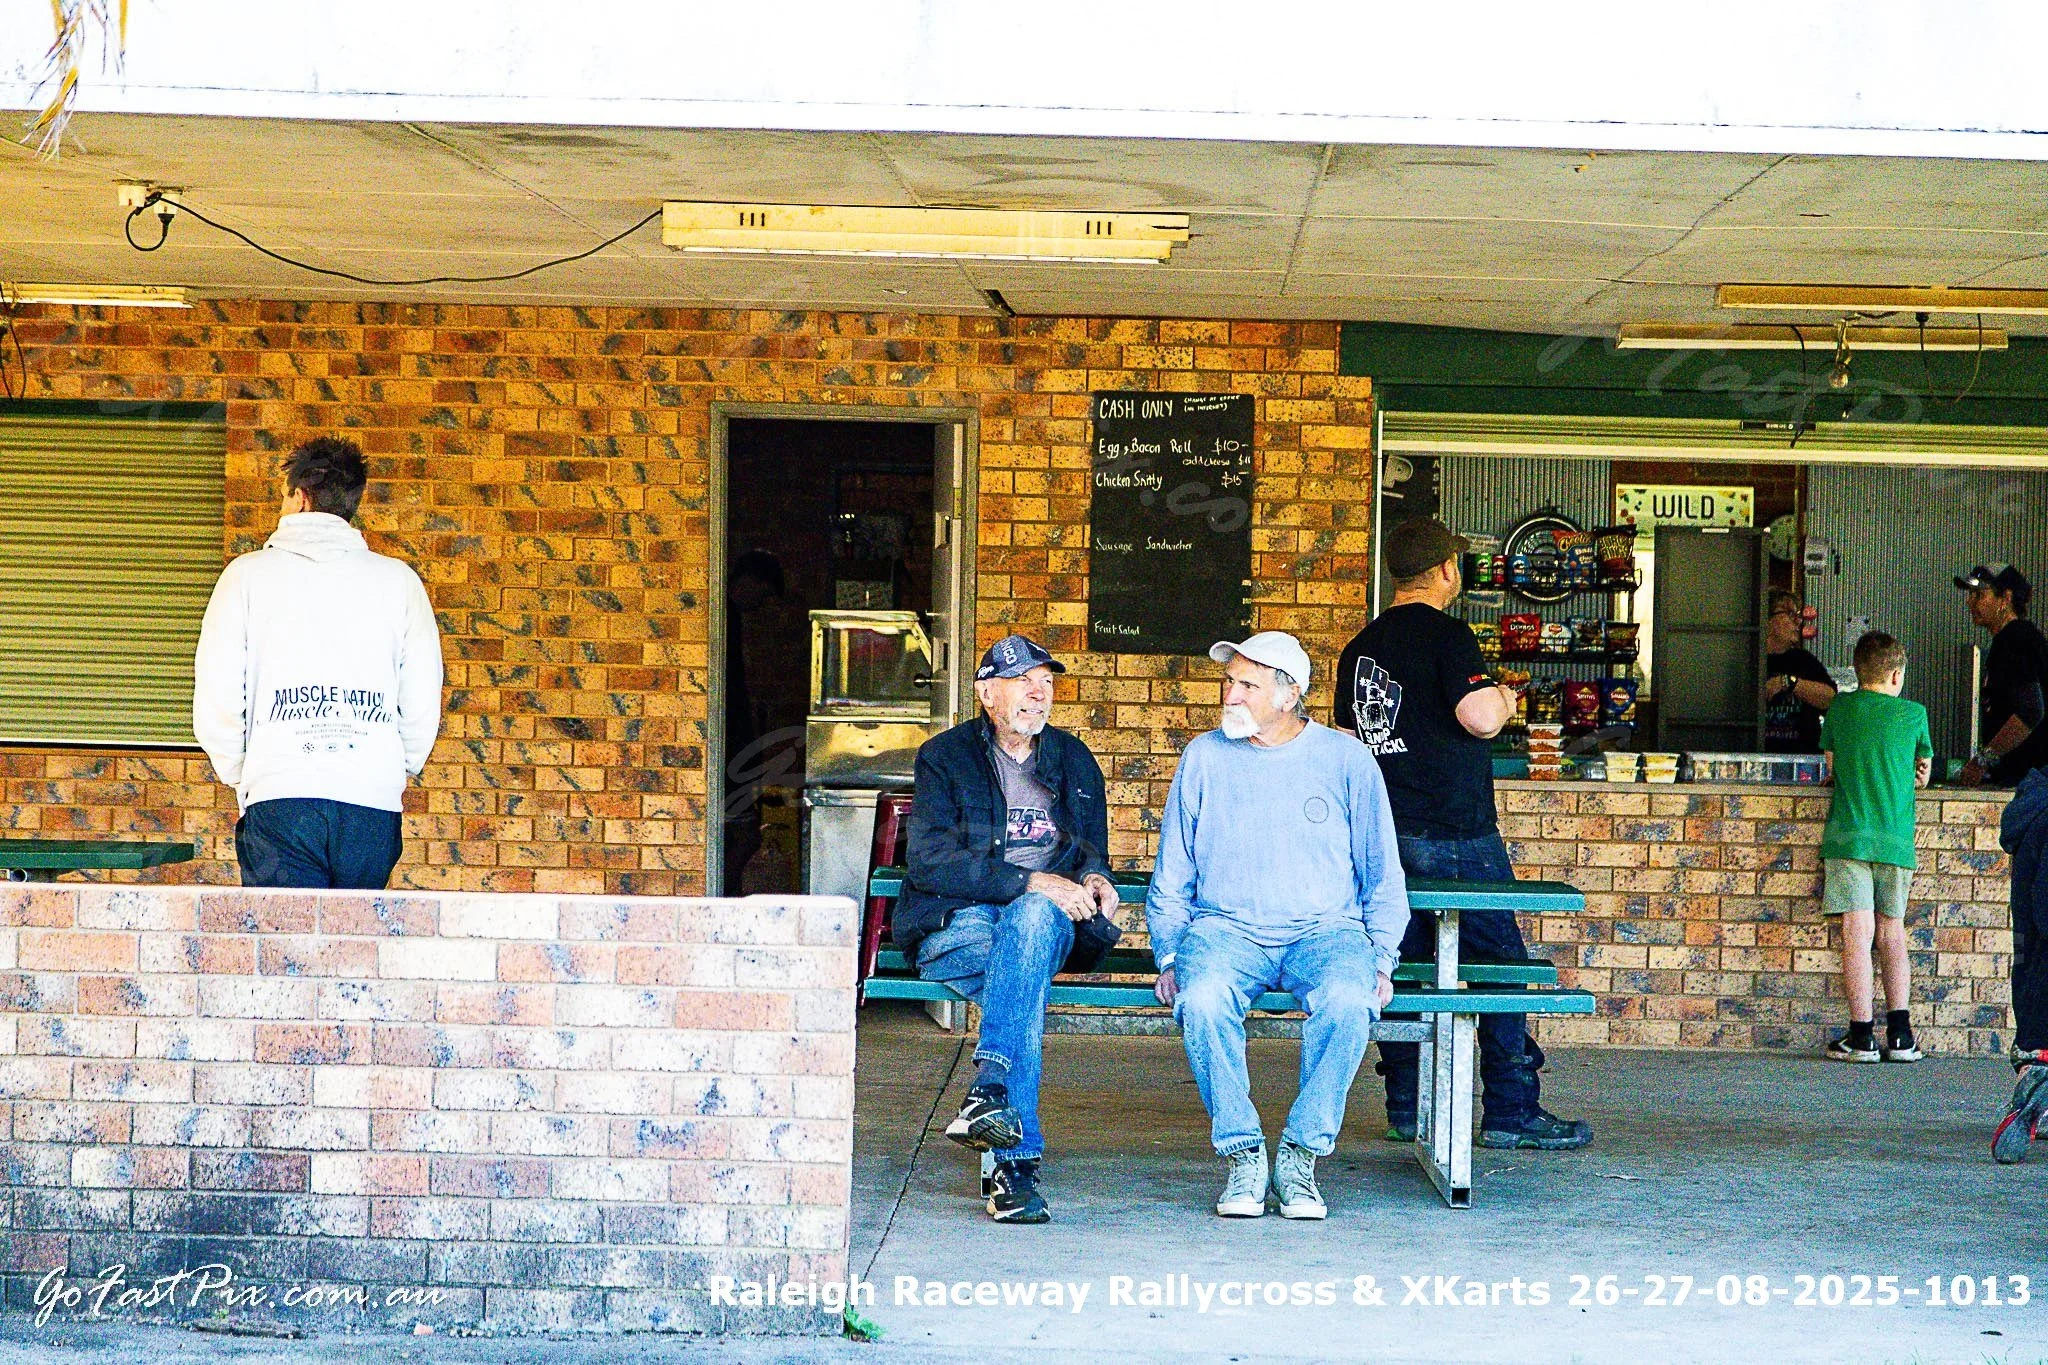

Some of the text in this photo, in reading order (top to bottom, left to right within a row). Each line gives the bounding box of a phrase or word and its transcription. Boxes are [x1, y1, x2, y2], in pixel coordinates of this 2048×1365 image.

[1100, 397, 1173, 419] CASH ONLY
[1099, 438, 1120, 459] Egg
[1130, 437, 1161, 455] Bacon
[1170, 438, 1192, 454] Roll
[1095, 471, 1131, 488] Chicken
[1653, 494, 1715, 520] WILD
[1094, 619, 1118, 635] Fruit
[274, 685, 339, 706] MUSCLE
